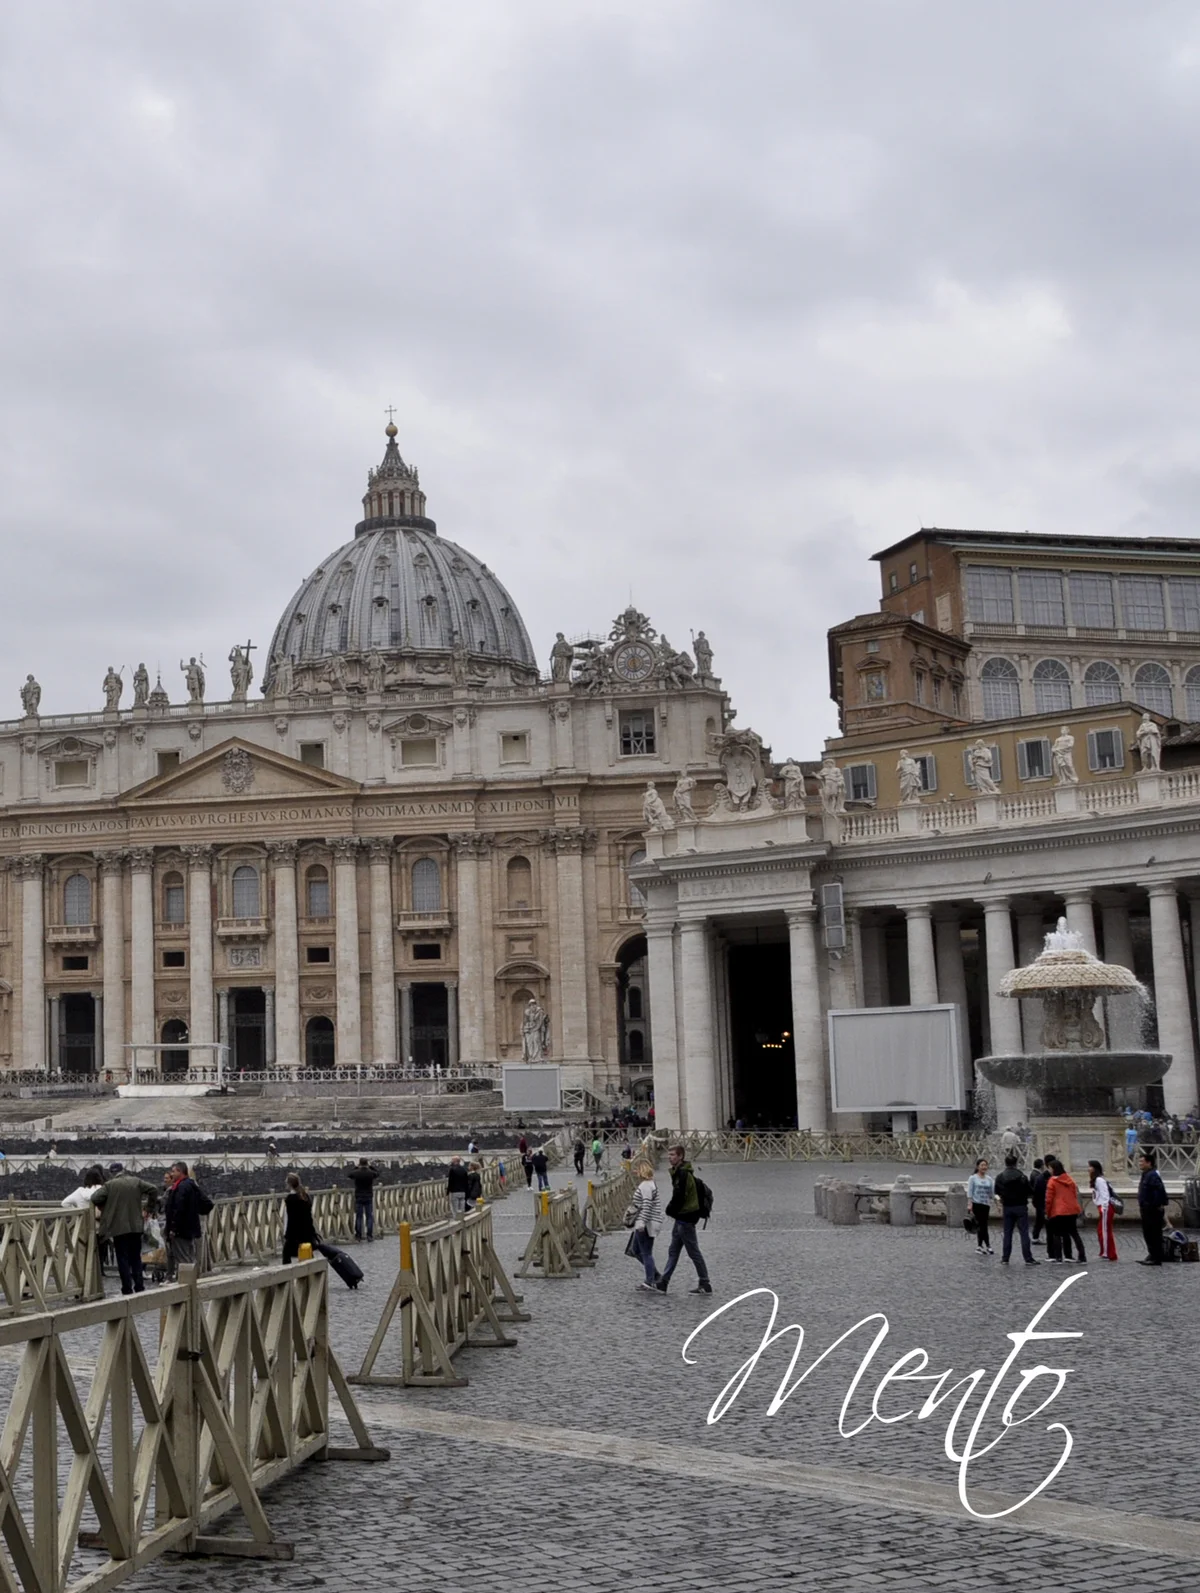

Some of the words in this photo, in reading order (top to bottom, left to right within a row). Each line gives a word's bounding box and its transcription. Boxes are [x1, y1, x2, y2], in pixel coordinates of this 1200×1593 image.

[20, 822, 87, 836] PRINCIPIS
[89, 819, 130, 832] APOST
[131, 816, 176, 828] PAVLVS
[178, 815, 187, 826] V
[189, 810, 276, 826] BVRGHESIVS
[279, 806, 351, 821] ROMANVS
[357, 805, 395, 818] PONT
[395, 803, 426, 816] MAX
[427, 802, 449, 815] AN
[514, 799, 554, 812] PONT
[556, 796, 578, 808] VII
